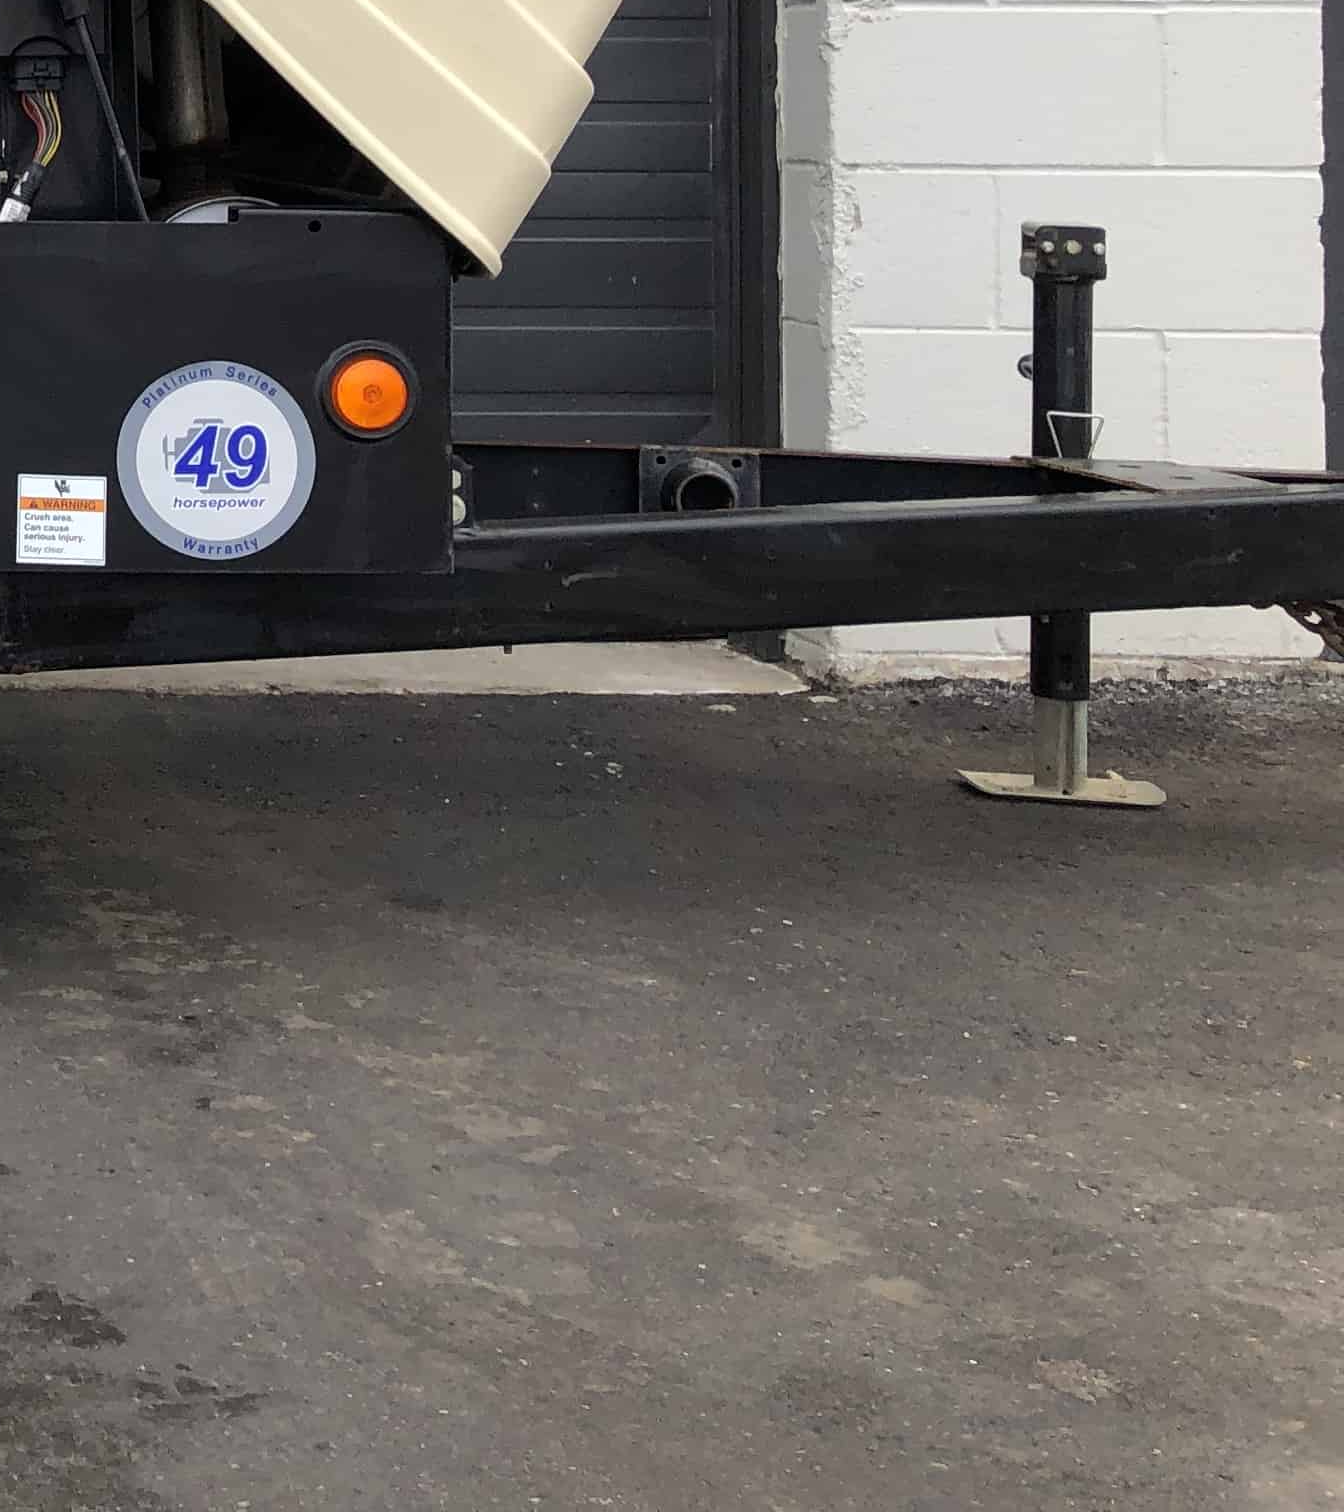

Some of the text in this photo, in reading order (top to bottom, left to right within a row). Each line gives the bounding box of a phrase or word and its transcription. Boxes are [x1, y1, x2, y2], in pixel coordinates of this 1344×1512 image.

[141, 365, 278, 409] Platinum Series
[173, 424, 268, 488] 49
[42, 500, 96, 511] WARNING
[173, 496, 266, 511] horsepower
[24, 512, 51, 521] Crush
[24, 522, 70, 532] Can cause
[23, 533, 86, 543] serious injury.
[23, 544, 42, 555] Stay
[183, 536, 259, 556] Warranty
